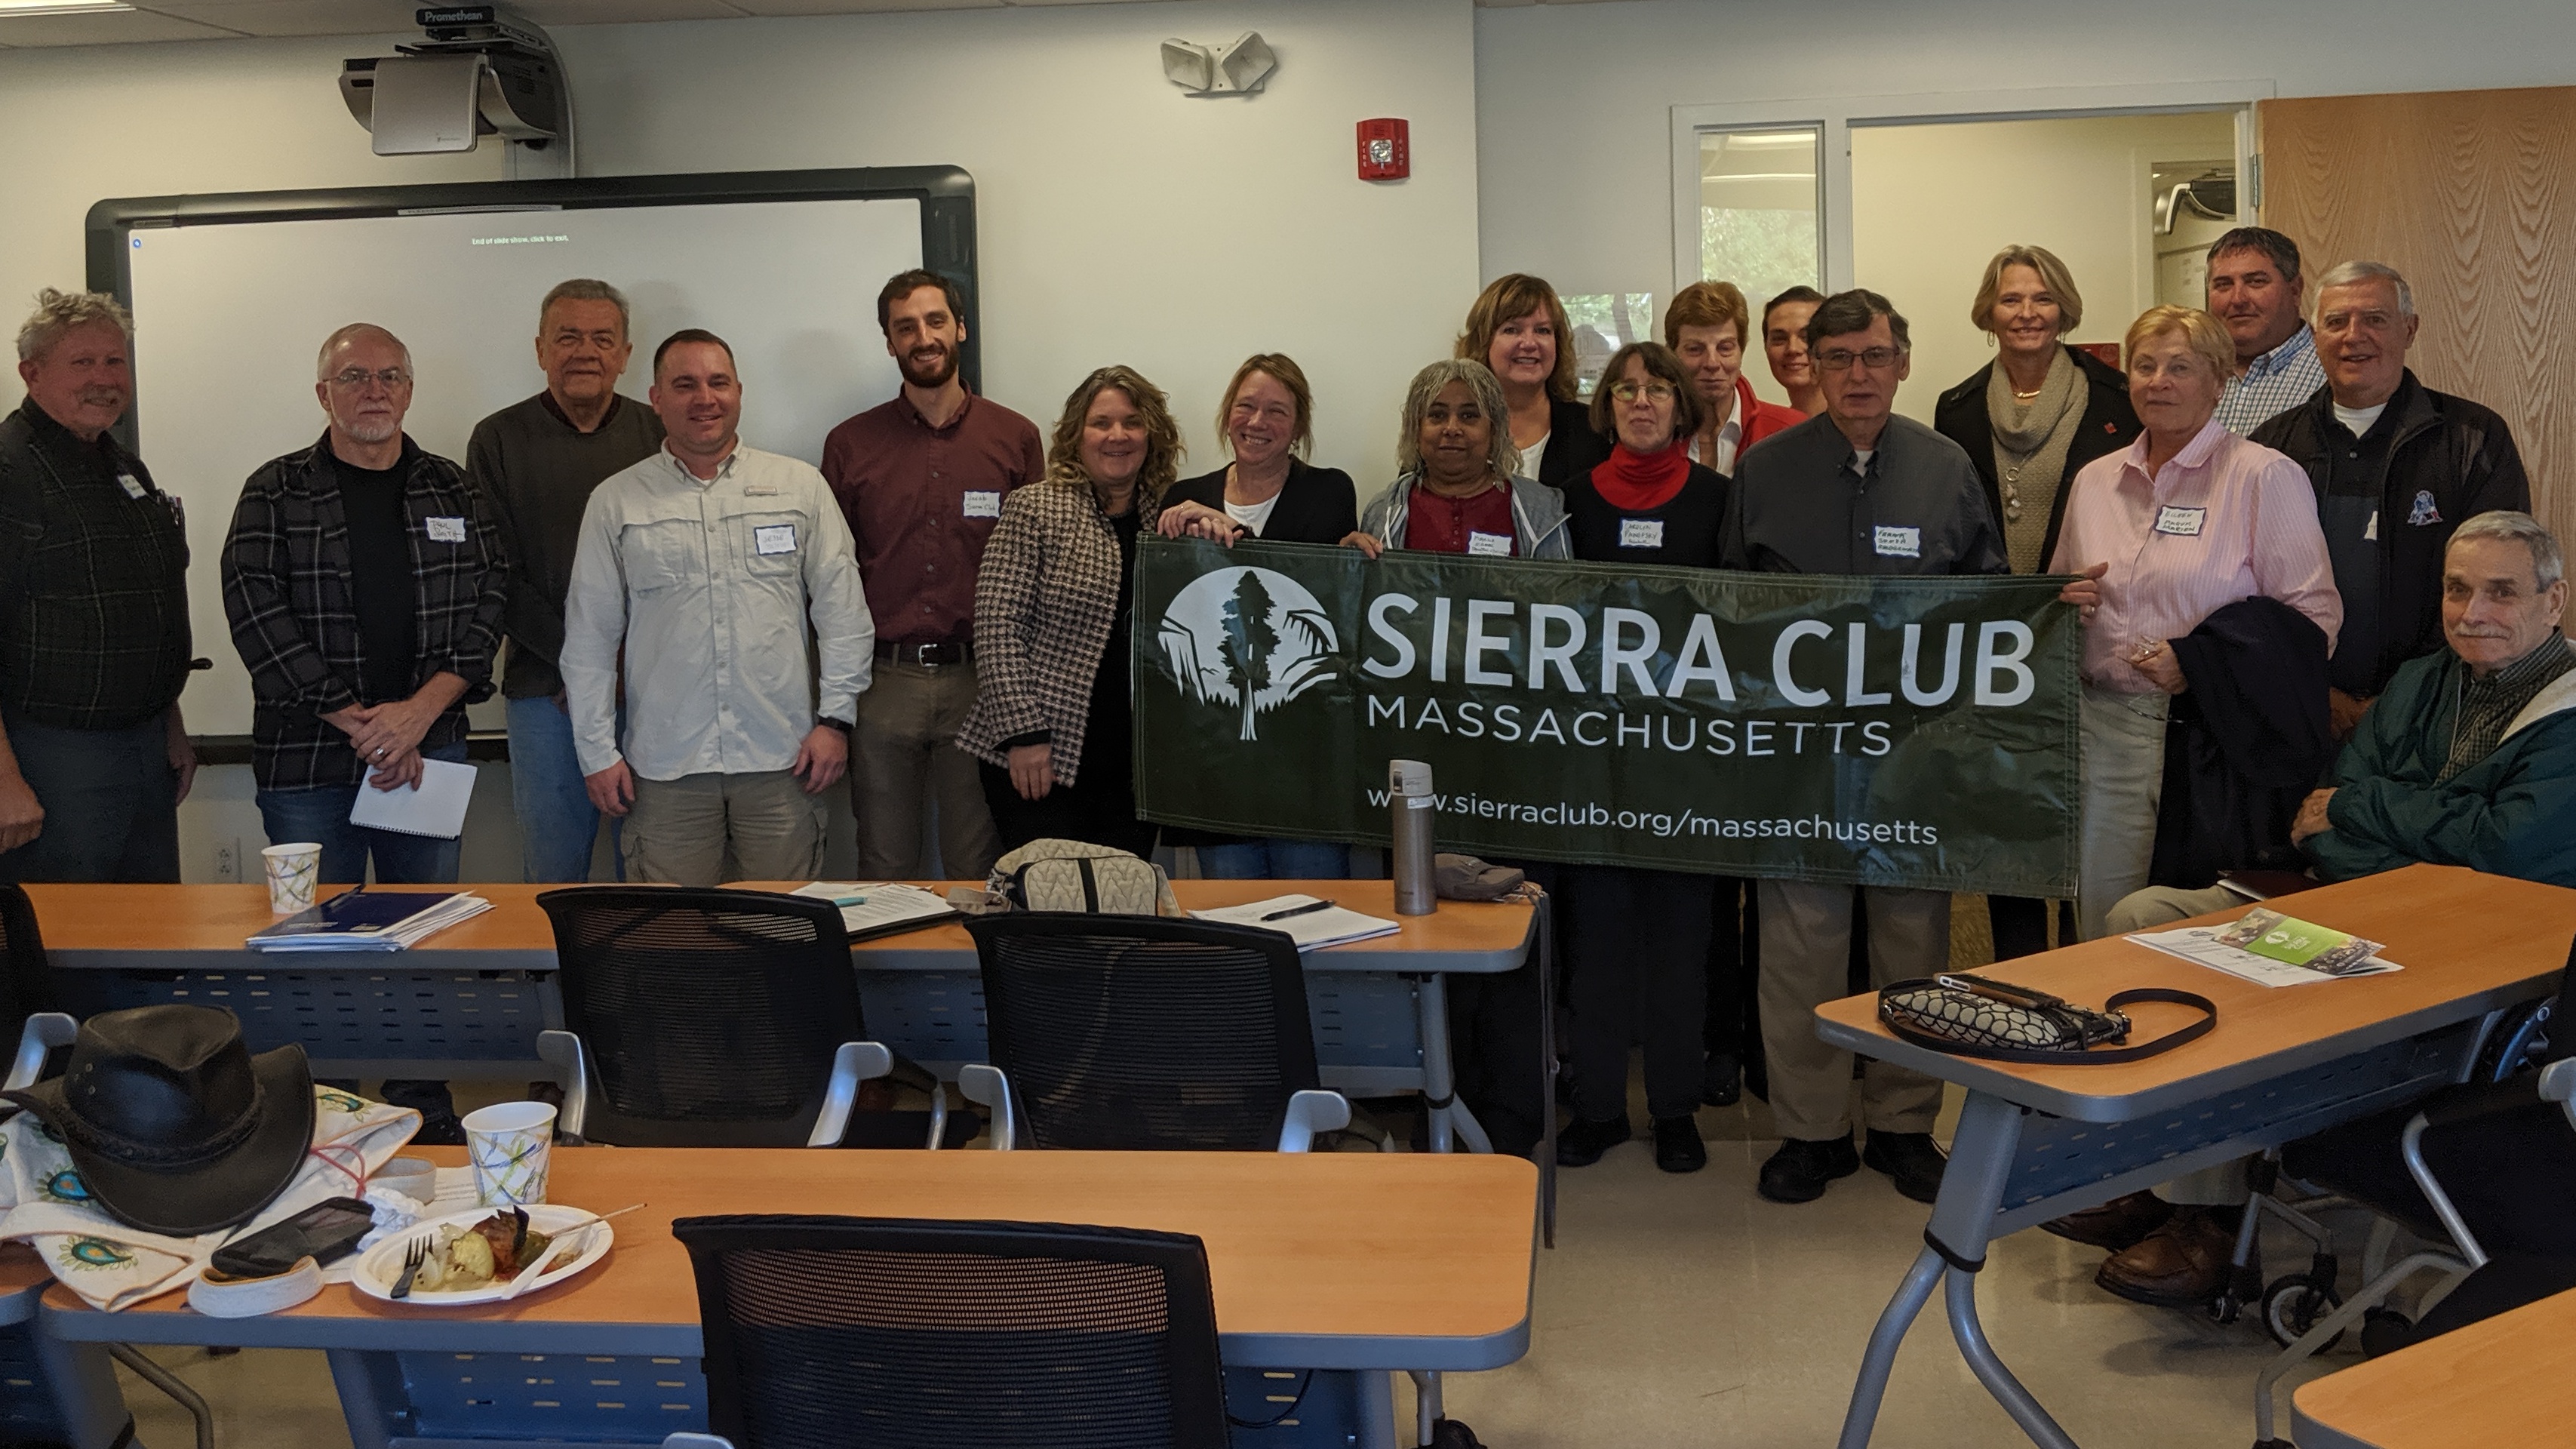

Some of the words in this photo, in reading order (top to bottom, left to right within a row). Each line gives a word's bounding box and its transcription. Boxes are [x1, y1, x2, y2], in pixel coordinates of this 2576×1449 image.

[425, 9, 483, 22] Promethean
[1361, 592, 1737, 702] SIERRA
[1772, 620, 2036, 707] CLUB
[1368, 694, 1891, 756] MASSACHUSETTS
[1367, 789, 1938, 845] ww.sierraclub.org/massachusetts
